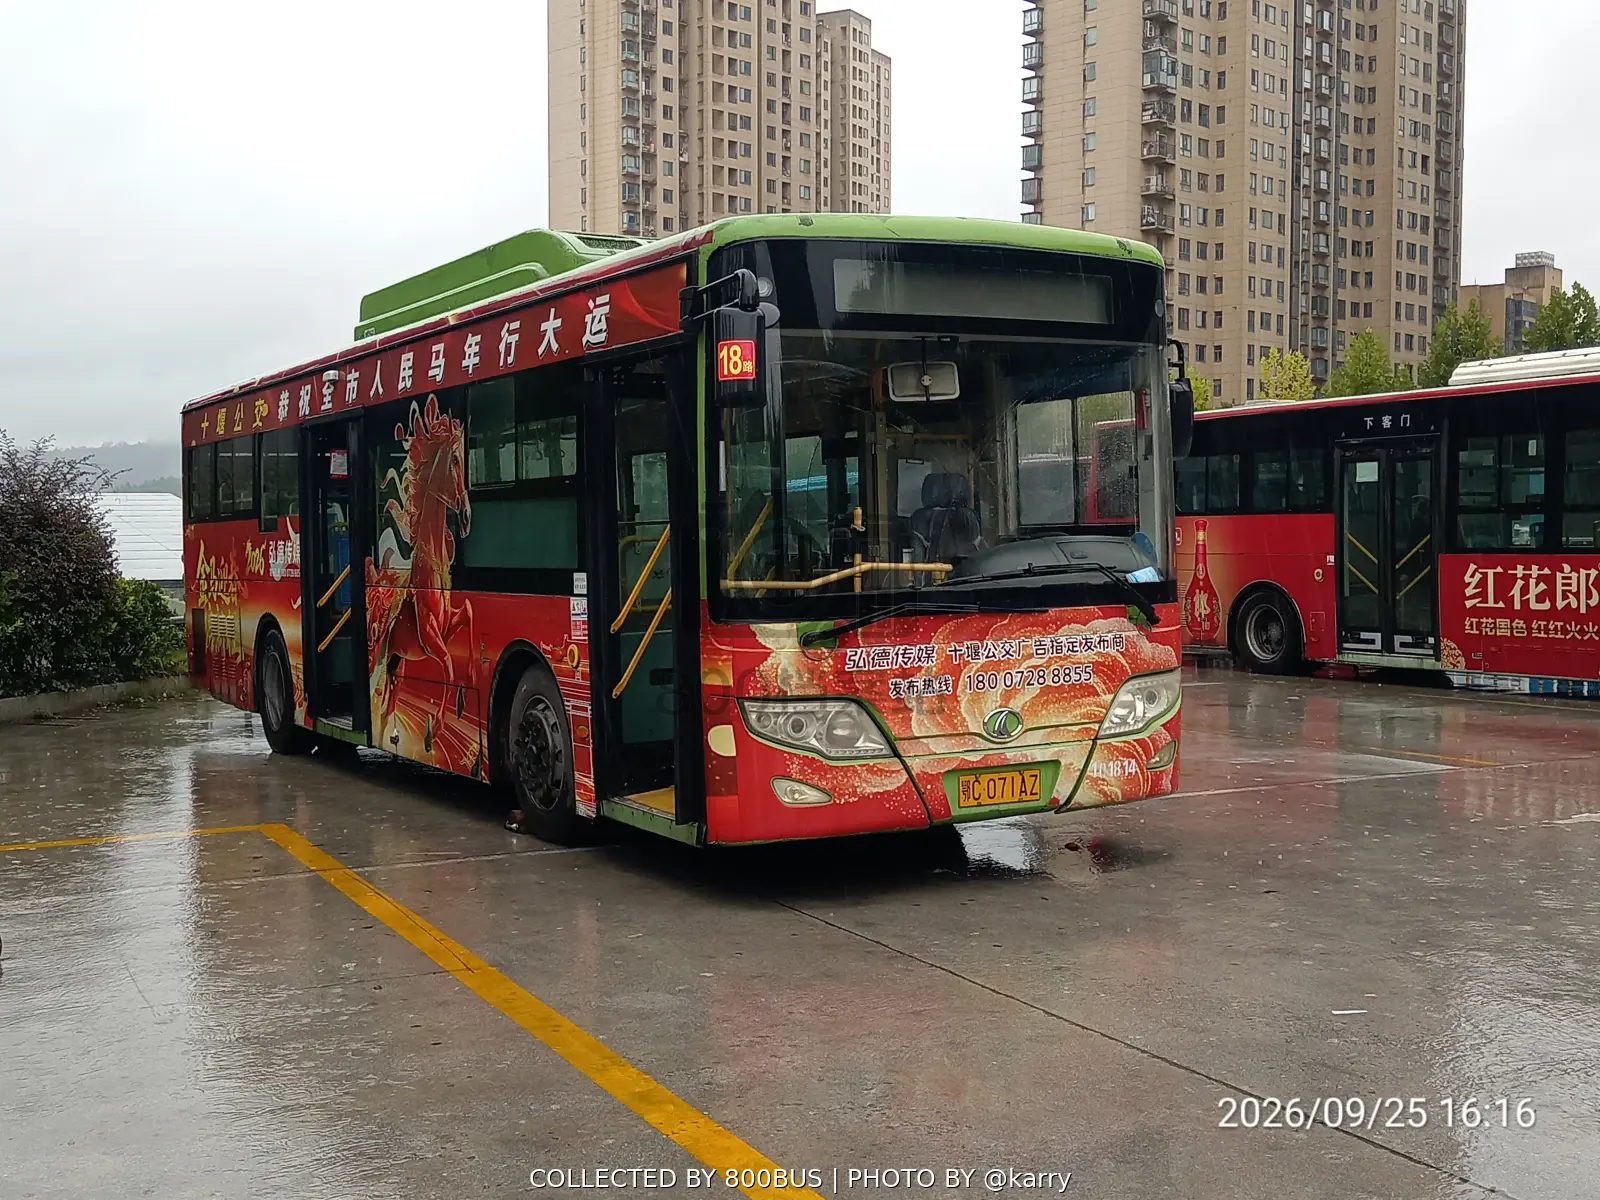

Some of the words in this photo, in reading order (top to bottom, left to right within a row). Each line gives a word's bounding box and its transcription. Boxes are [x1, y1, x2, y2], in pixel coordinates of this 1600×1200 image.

[719, 345, 753, 375] 18路
[200, 398, 266, 439] 十堰公交
[1364, 414, 1411, 430] 下客门
[1464, 562, 1600, 614] 红花郎
[1464, 617, 1528, 637] 红花国色
[1531, 619, 1600, 641] 红红火火
[845, 645, 938, 671] 弘德传媒
[947, 633, 1126, 664] 十堰公交广告指定发布商
[889, 676, 952, 699] 发布热线
[966, 673, 999, 692] 180
[1003, 669, 1047, 689] 0728
[1051, 664, 1093, 684] 8855
